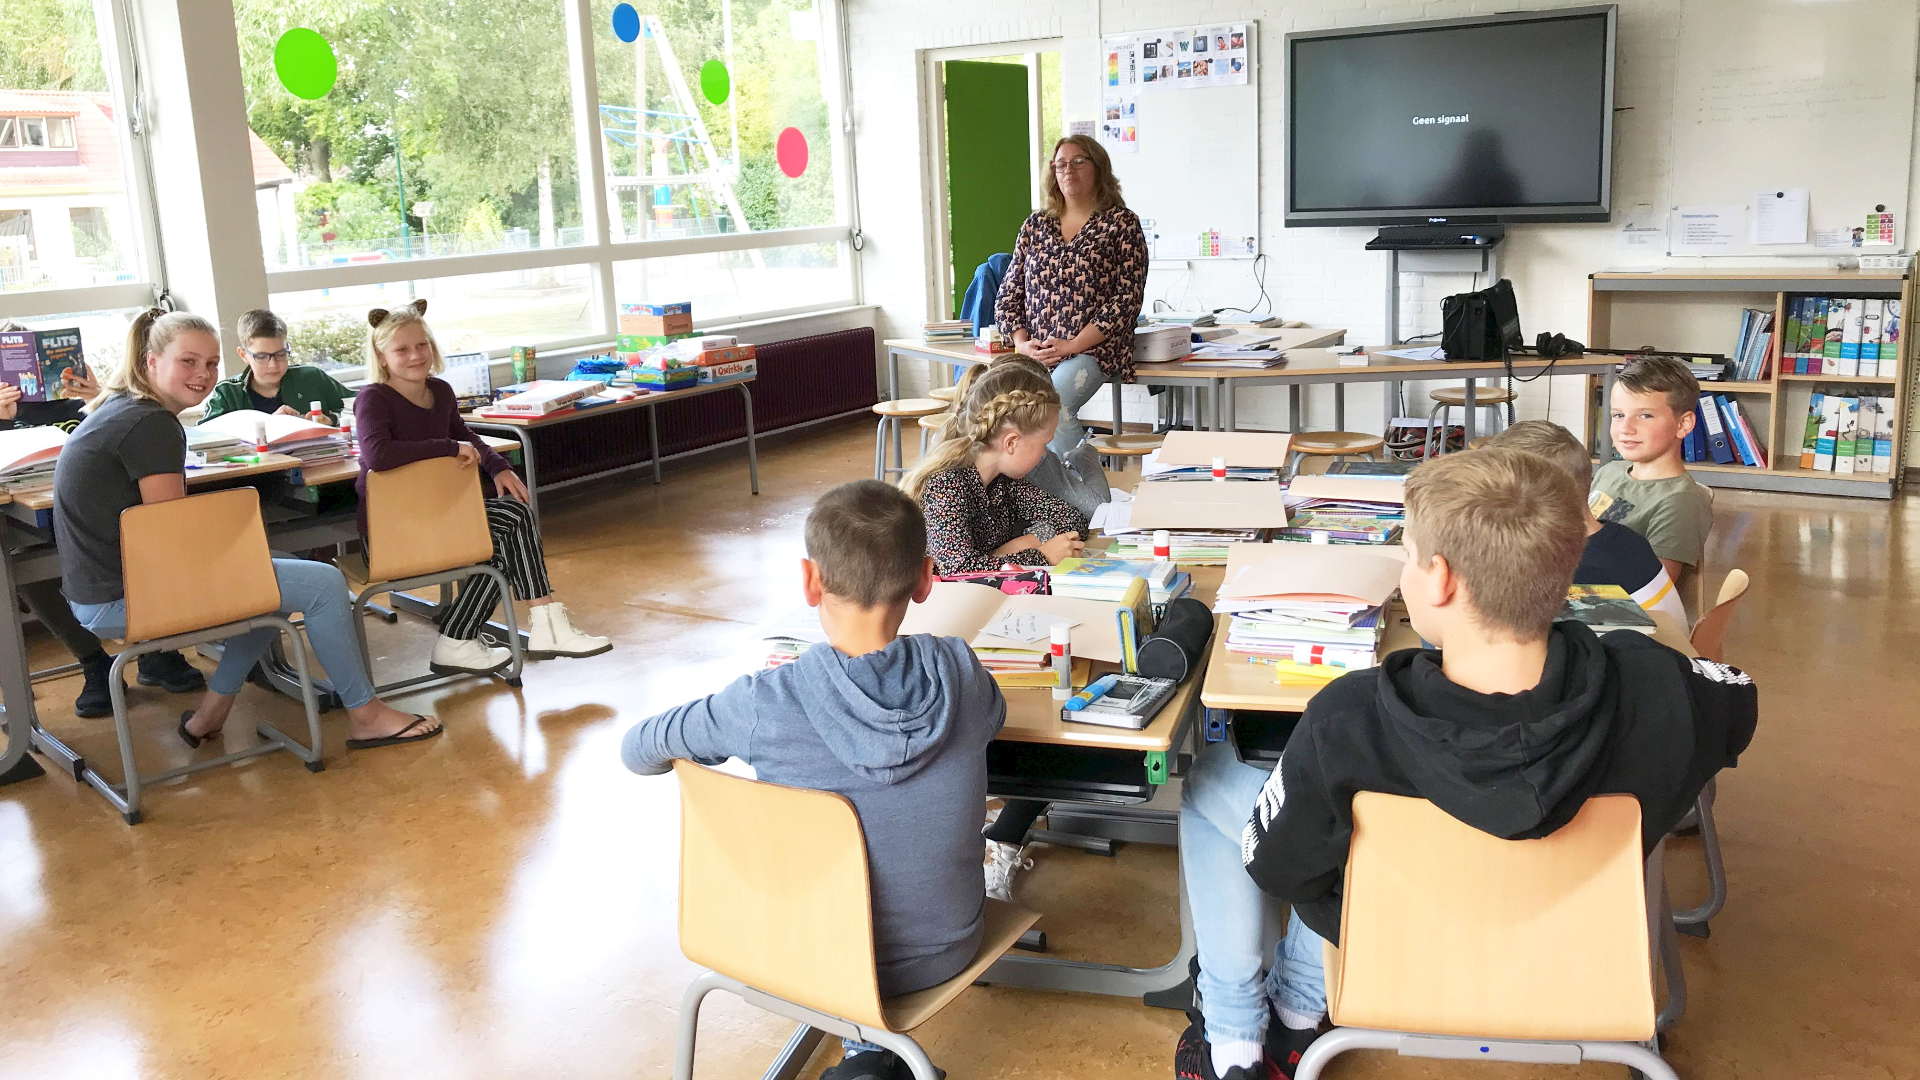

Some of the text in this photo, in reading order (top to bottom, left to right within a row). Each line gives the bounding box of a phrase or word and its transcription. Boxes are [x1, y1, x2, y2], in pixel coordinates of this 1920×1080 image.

[1412, 113, 1470, 126] Geen signaal
[717, 365, 743, 375] Qwirkle
